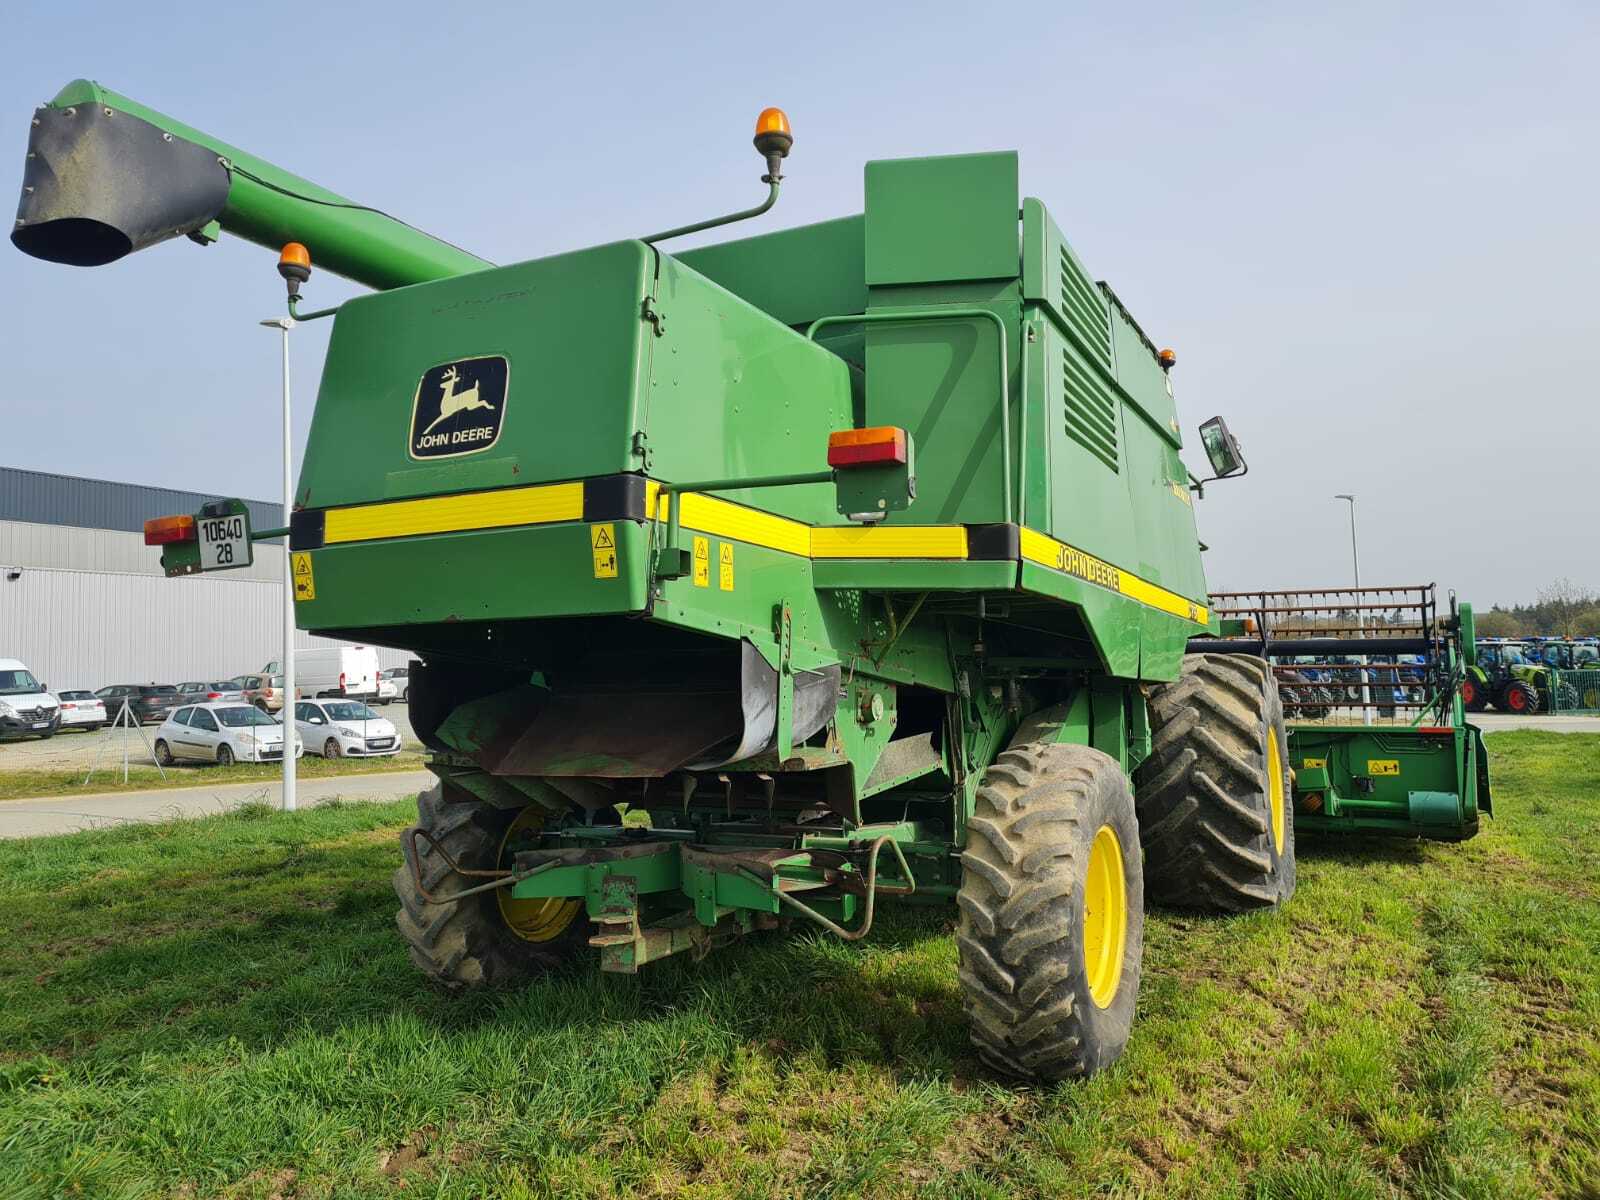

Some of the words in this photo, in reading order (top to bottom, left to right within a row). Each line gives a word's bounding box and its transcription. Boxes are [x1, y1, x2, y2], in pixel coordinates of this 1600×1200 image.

[416, 432, 448, 449] JOHN
[452, 427, 494, 443] DEERE
[203, 519, 243, 542] 10640
[216, 543, 233, 564] 28
[1056, 545, 1087, 577] JOHN
[1088, 558, 1119, 591] DEERE
